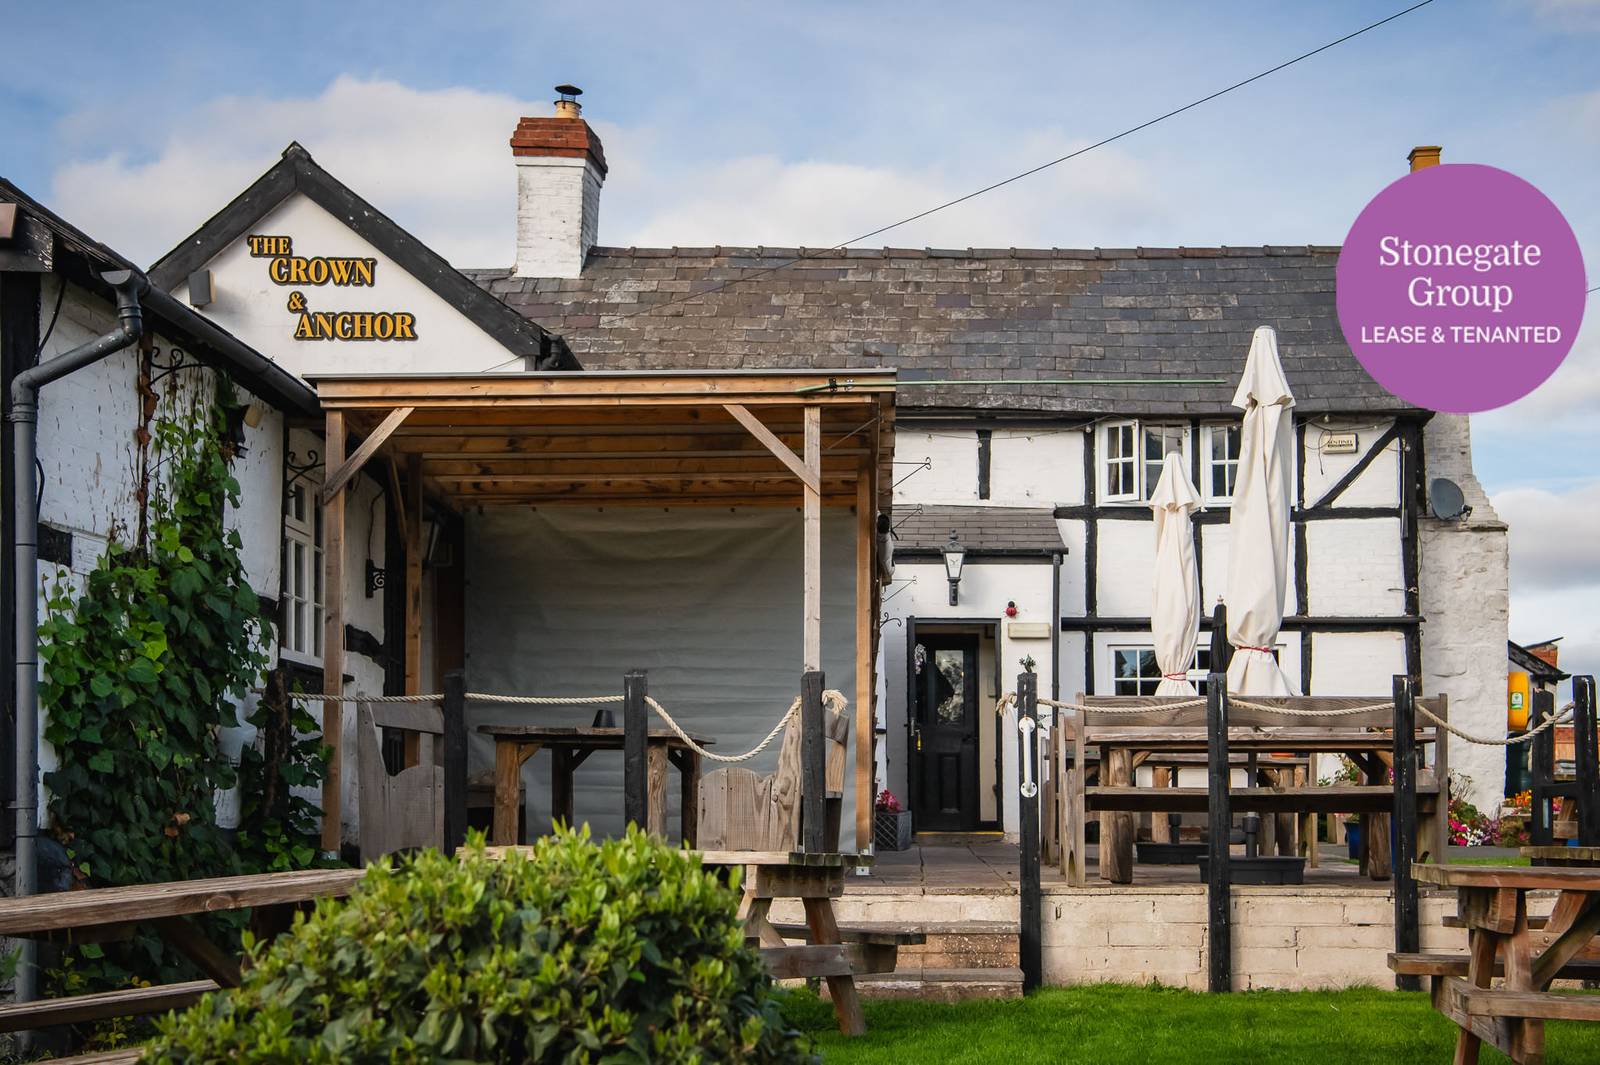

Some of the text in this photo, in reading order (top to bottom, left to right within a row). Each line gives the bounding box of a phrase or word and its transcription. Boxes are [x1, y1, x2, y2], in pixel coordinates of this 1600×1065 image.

[248, 236, 291, 256] THE
[270, 257, 375, 286] CROWN
[288, 292, 306, 311] &
[294, 313, 417, 340] ANCHOR
